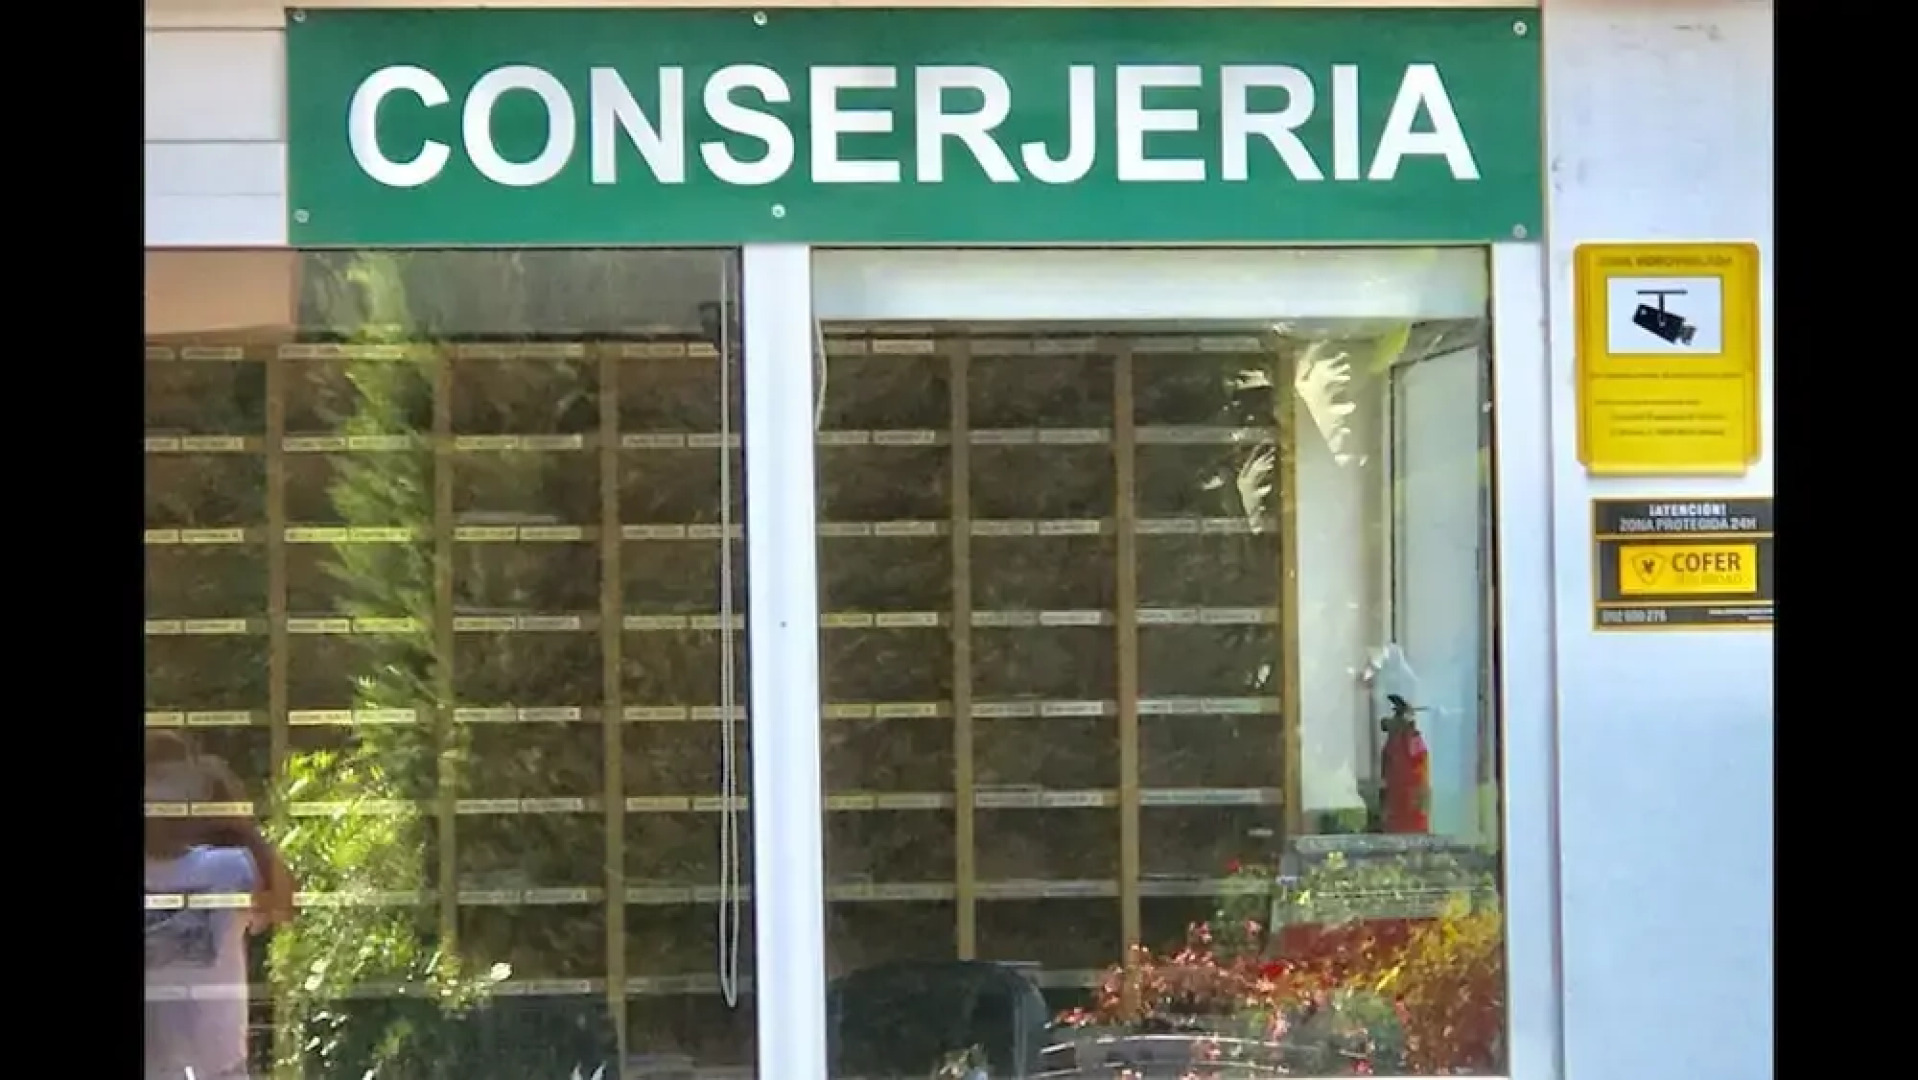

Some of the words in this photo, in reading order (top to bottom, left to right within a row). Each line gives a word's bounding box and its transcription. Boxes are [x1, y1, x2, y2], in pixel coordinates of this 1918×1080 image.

[349, 64, 1479, 187] CONSERJERIA
[1619, 518, 1654, 532] ZONA
[1656, 518, 1728, 531] PROTEGIDA
[1671, 552, 1742, 572] COFER
